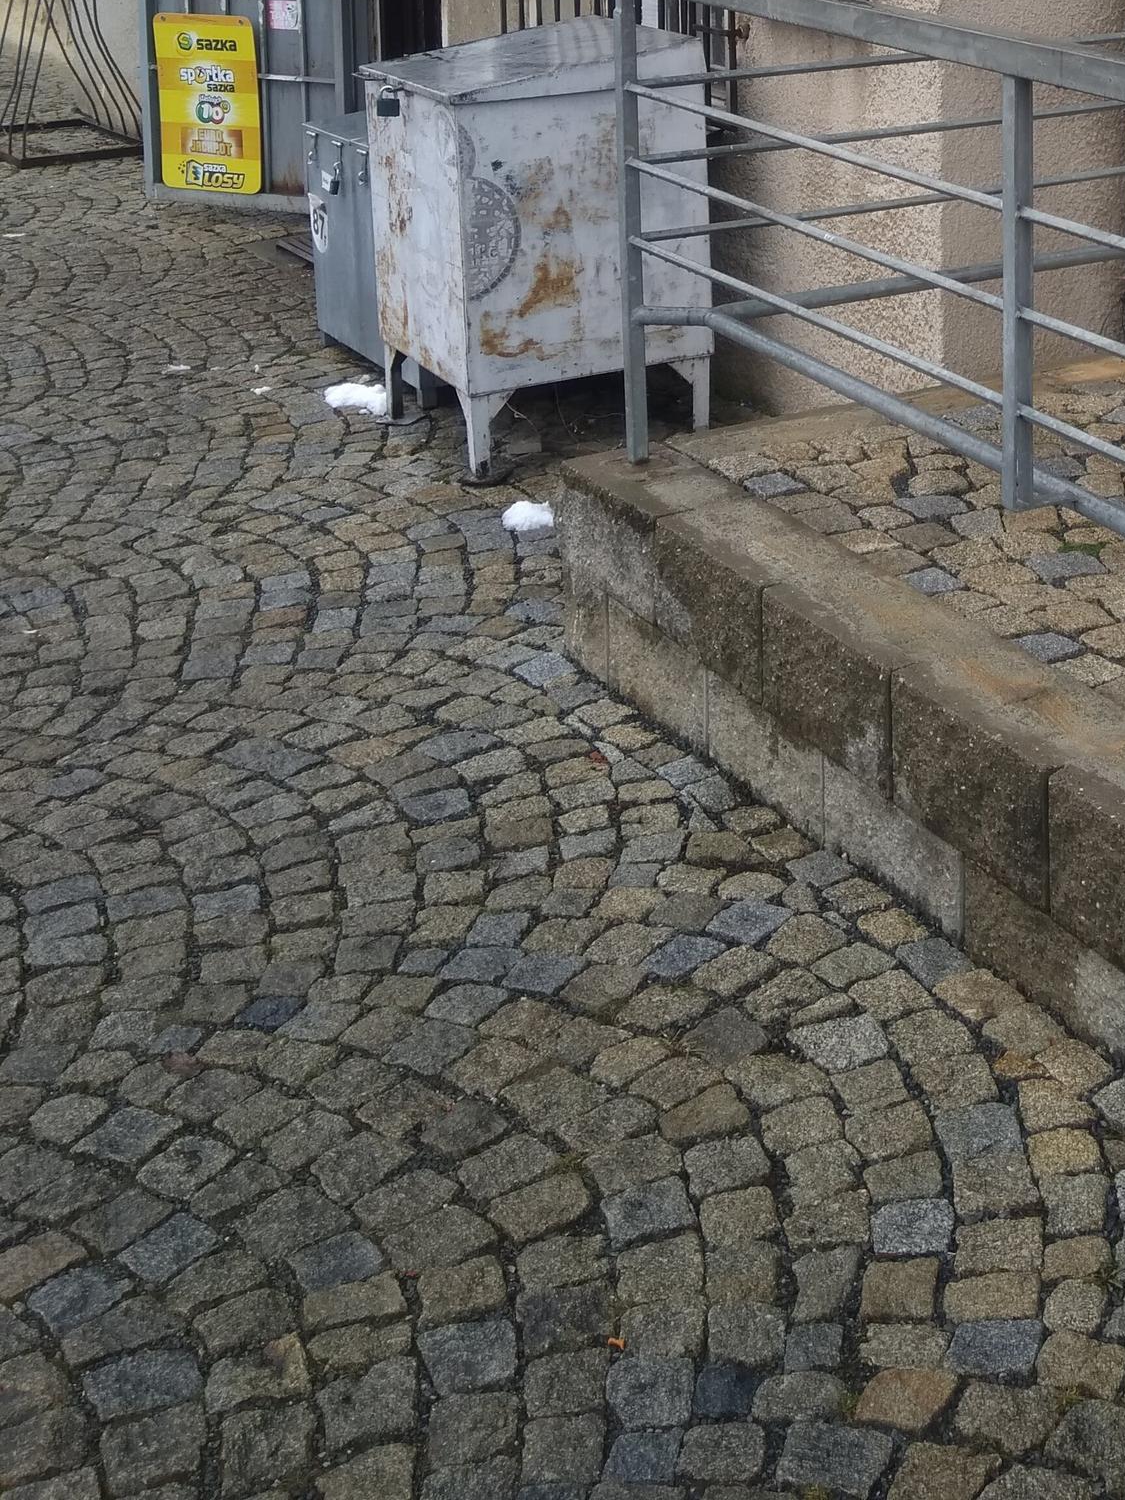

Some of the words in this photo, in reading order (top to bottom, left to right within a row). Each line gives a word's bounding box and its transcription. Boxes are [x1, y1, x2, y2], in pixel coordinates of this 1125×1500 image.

[196, 38, 238, 52] sazka
[180, 65, 235, 85] sportka
[206, 83, 235, 93] sazka
[198, 128, 224, 142] EURO
[190, 139, 233, 156] JACKPOT
[204, 163, 226, 172] sazka
[203, 172, 245, 189] LOSY
